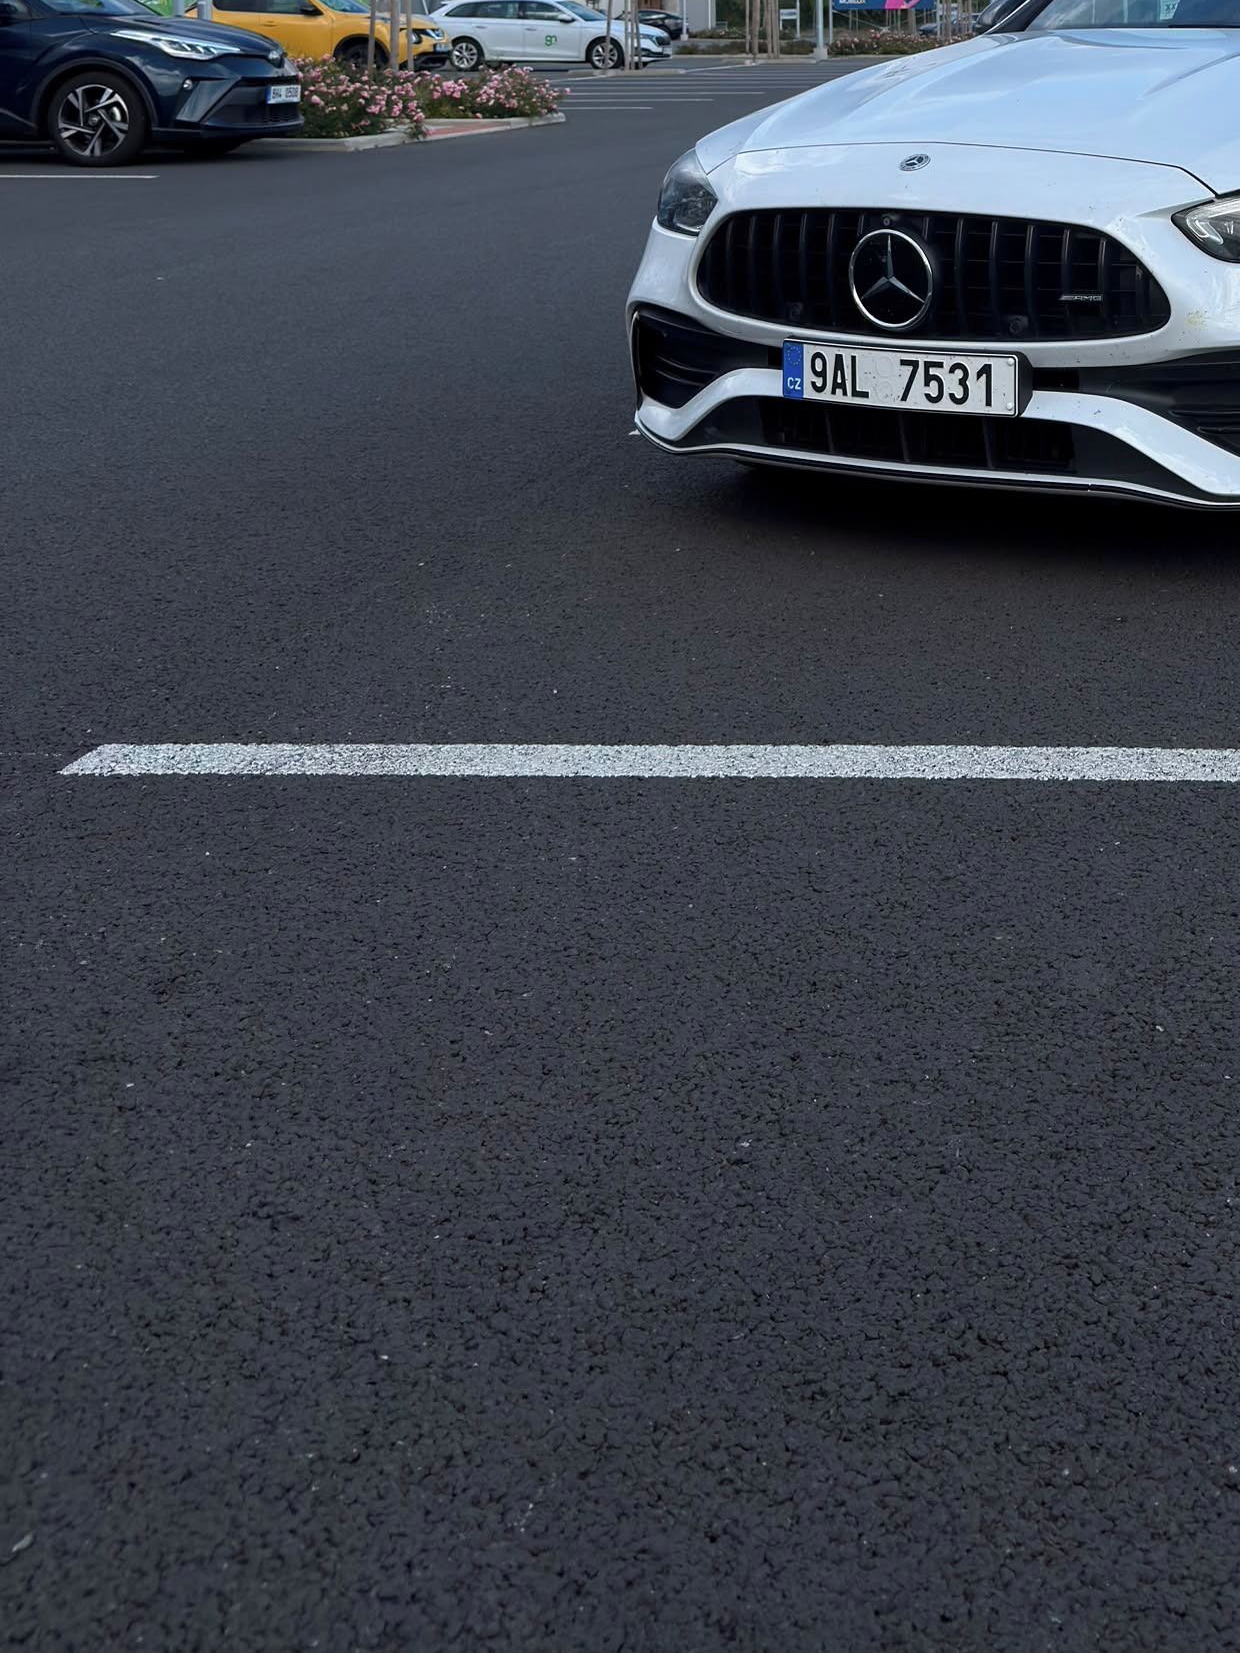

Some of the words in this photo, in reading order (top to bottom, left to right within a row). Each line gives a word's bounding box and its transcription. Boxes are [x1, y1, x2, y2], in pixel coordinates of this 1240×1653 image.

[787, 377, 802, 390] CZ
[810, 351, 870, 399] 9AL
[899, 358, 993, 407] 7531
